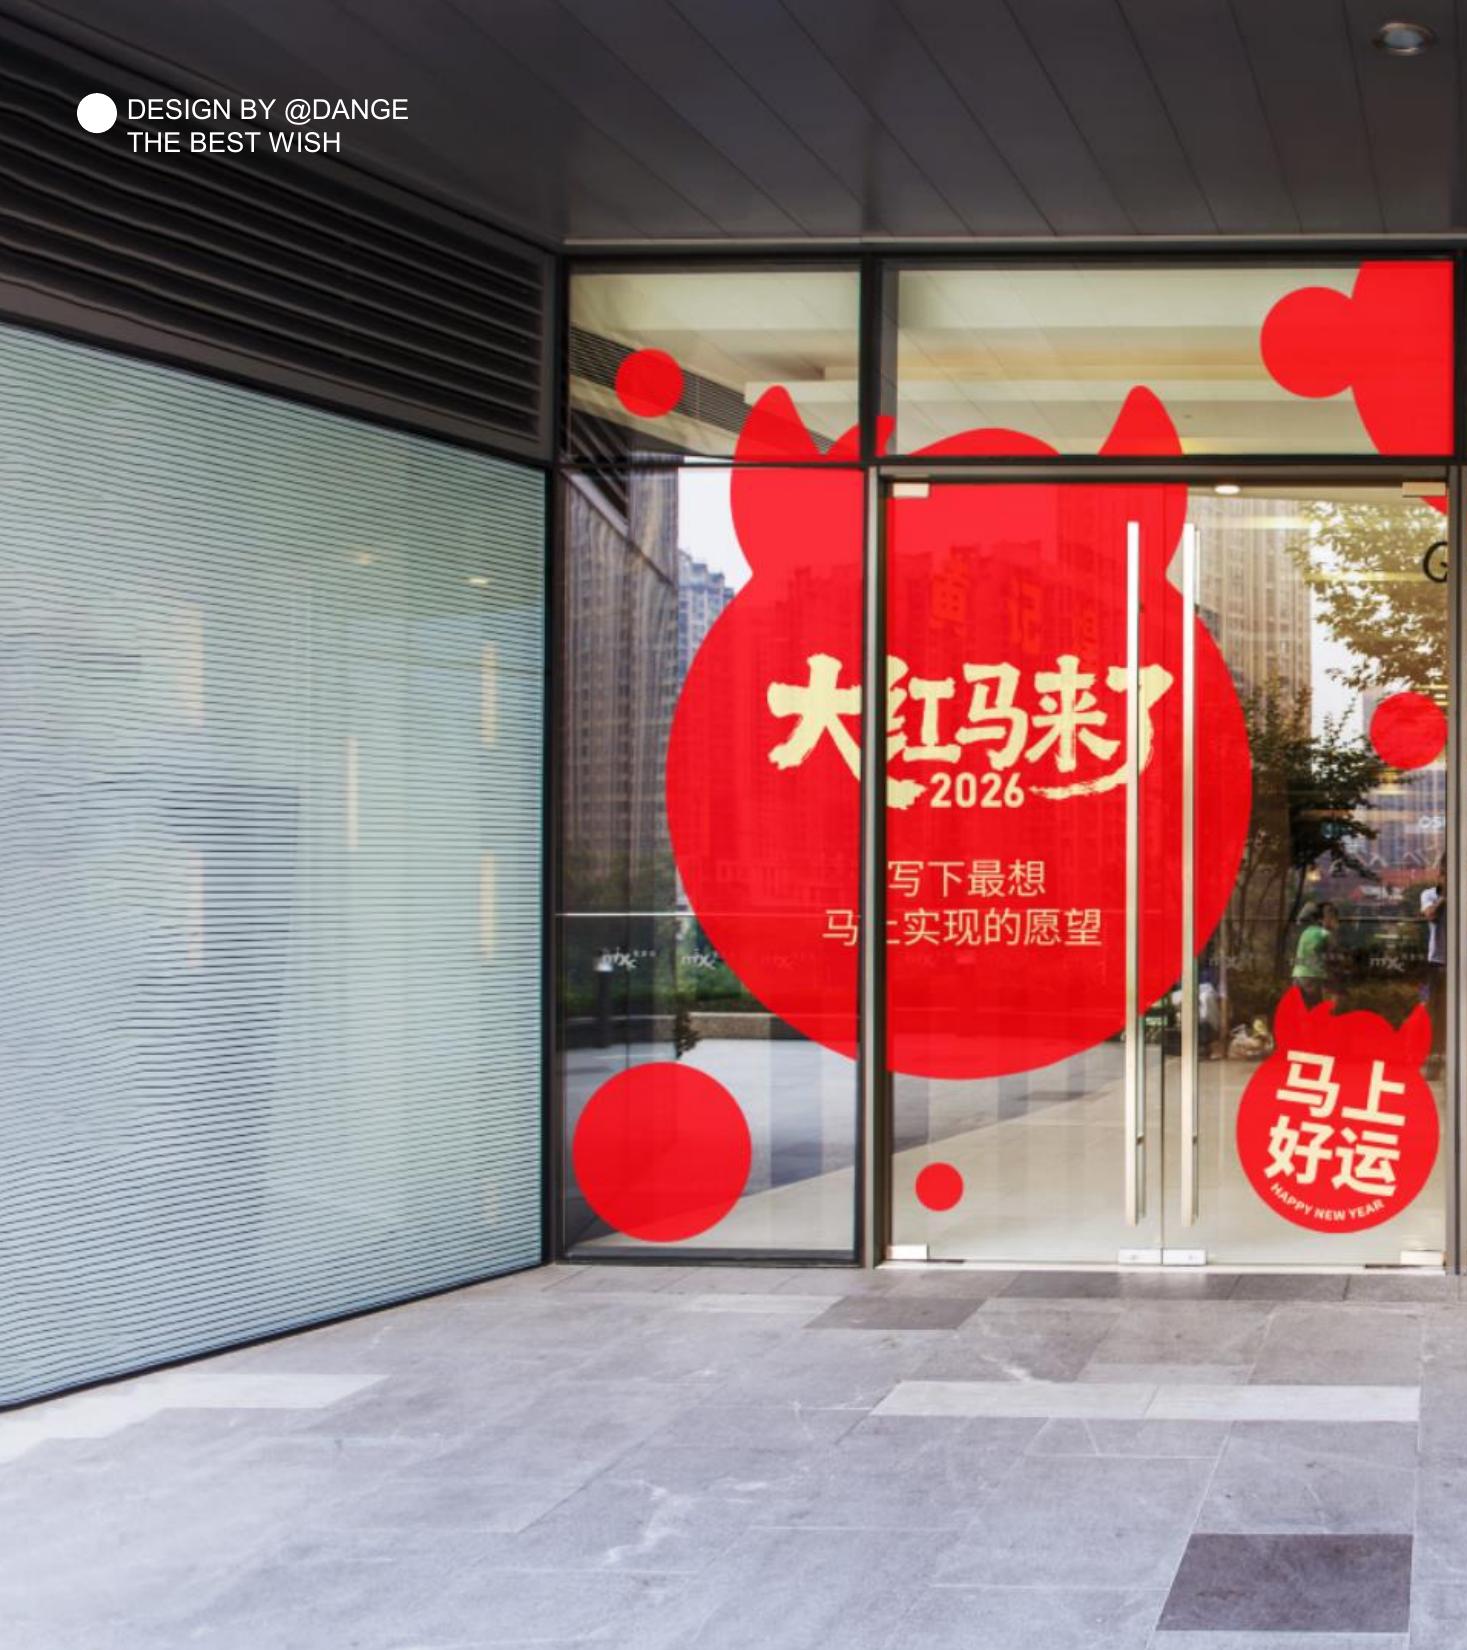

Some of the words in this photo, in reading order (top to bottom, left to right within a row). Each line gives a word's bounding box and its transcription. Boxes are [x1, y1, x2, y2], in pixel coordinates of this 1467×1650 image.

[766, 653, 1175, 810] 大红马来了
[930, 772, 1026, 809] 2026
[887, 859, 1046, 898] 写下最想
[1275, 1049, 1406, 1127] 马上
[1263, 1114, 1401, 1198] 好运
[1269, 1182, 1313, 1215] HAPPY
[1314, 1206, 1346, 1222] NEW
[1349, 1198, 1385, 1219] YEAR
